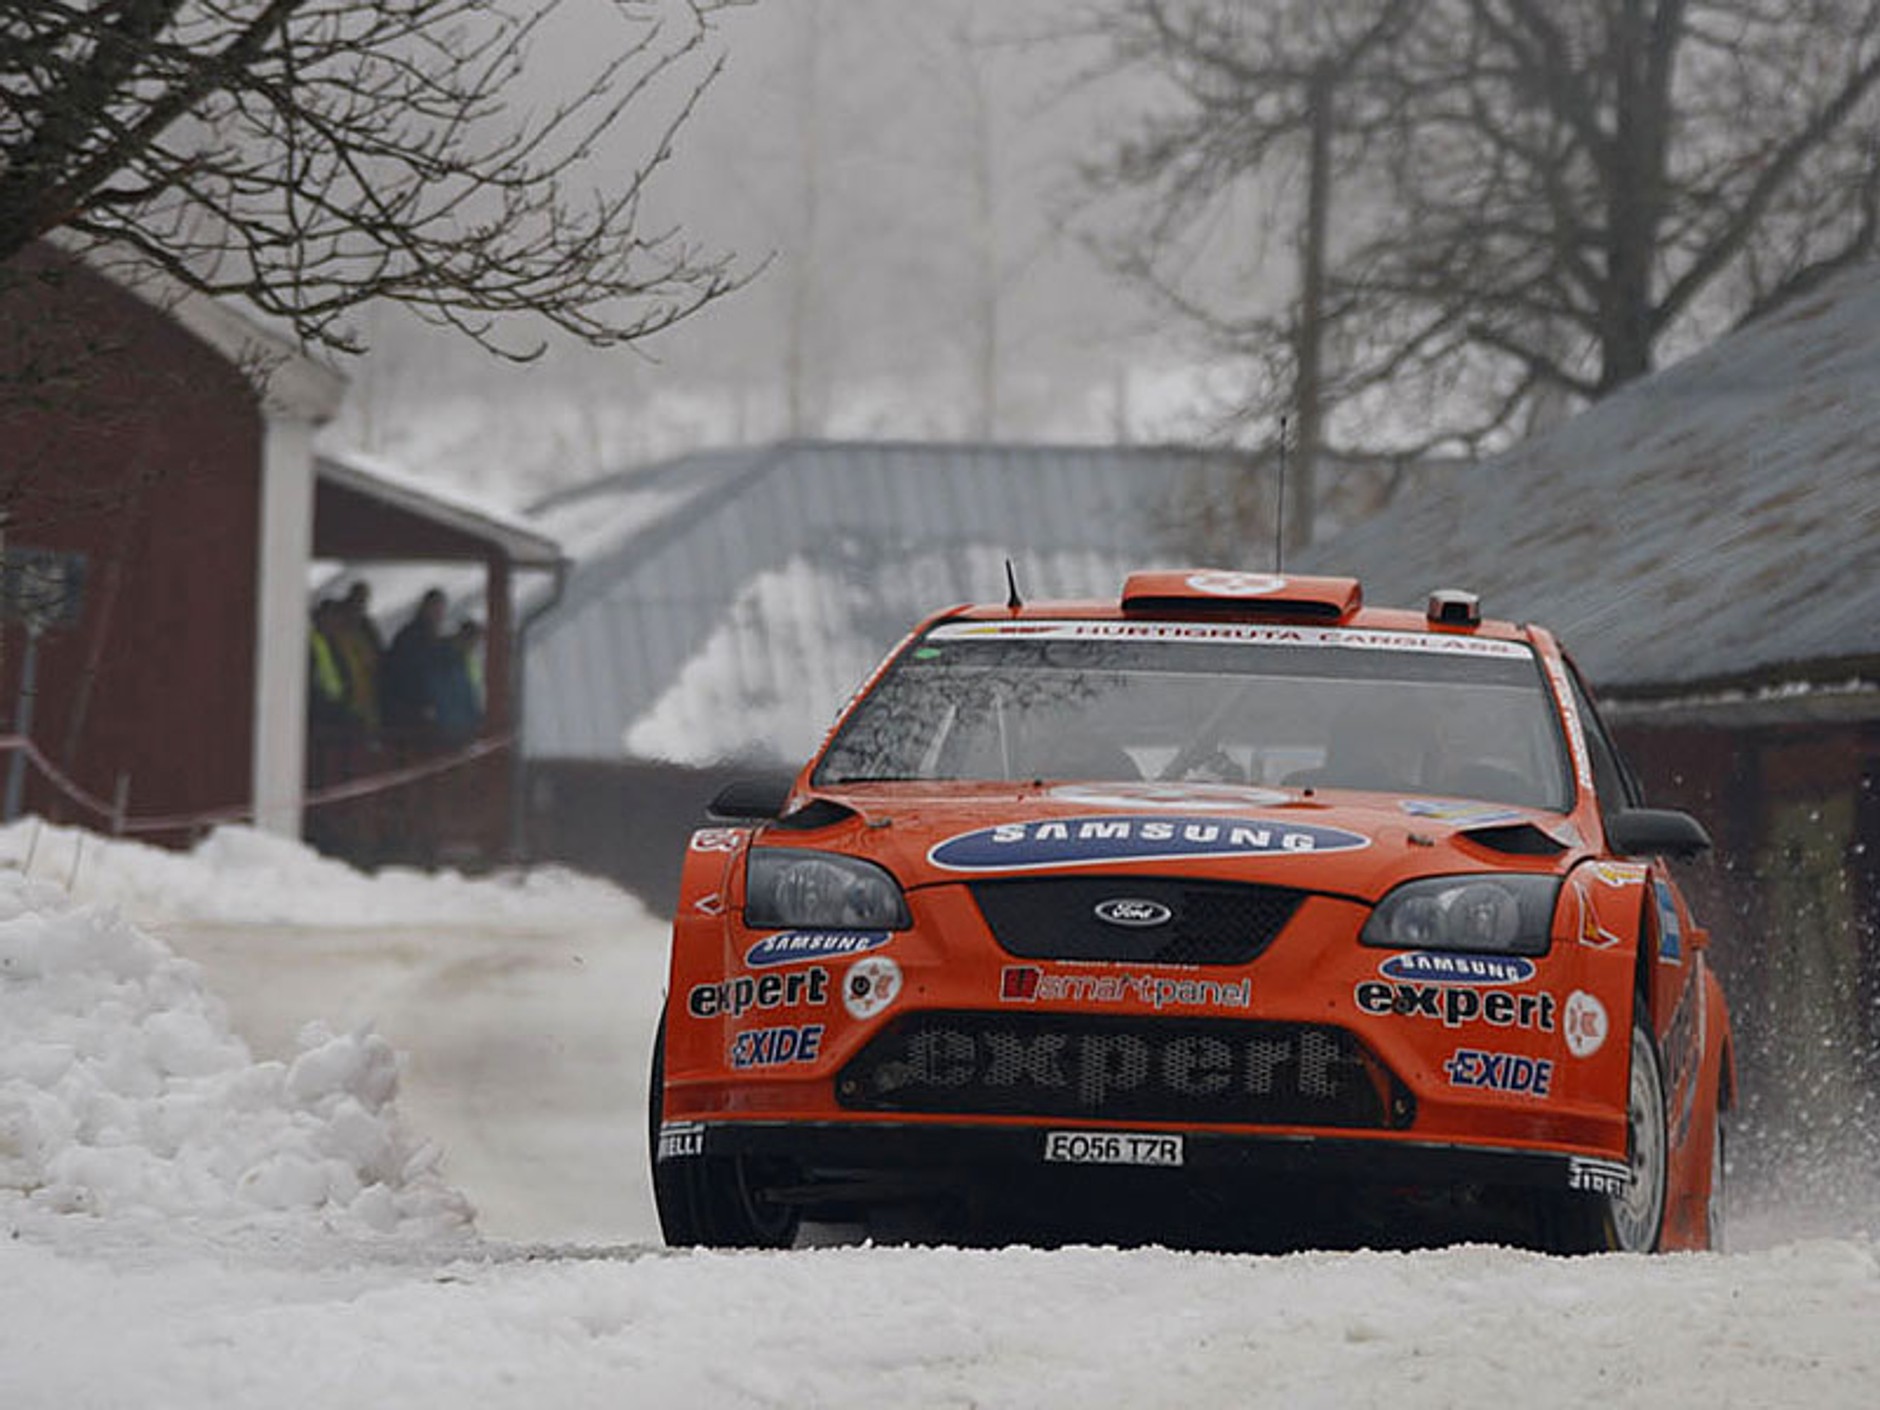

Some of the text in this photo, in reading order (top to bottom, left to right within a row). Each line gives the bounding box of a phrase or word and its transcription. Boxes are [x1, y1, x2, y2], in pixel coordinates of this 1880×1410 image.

[992, 821, 1316, 853] SAMSUNG
[1111, 904, 1153, 919] Ford
[763, 933, 870, 951] SAMSUNG
[1401, 953, 1520, 982] SAMSUNG
[689, 966, 828, 1018] expert
[1037, 973, 1251, 1008] smartpanel
[1355, 981, 1555, 1031] expert
[731, 1025, 824, 1070] EXIDE
[907, 1026, 1341, 1104] expert
[1444, 1048, 1552, 1097] EXIDE
[1052, 1136, 1177, 1163] EO56 TZR
